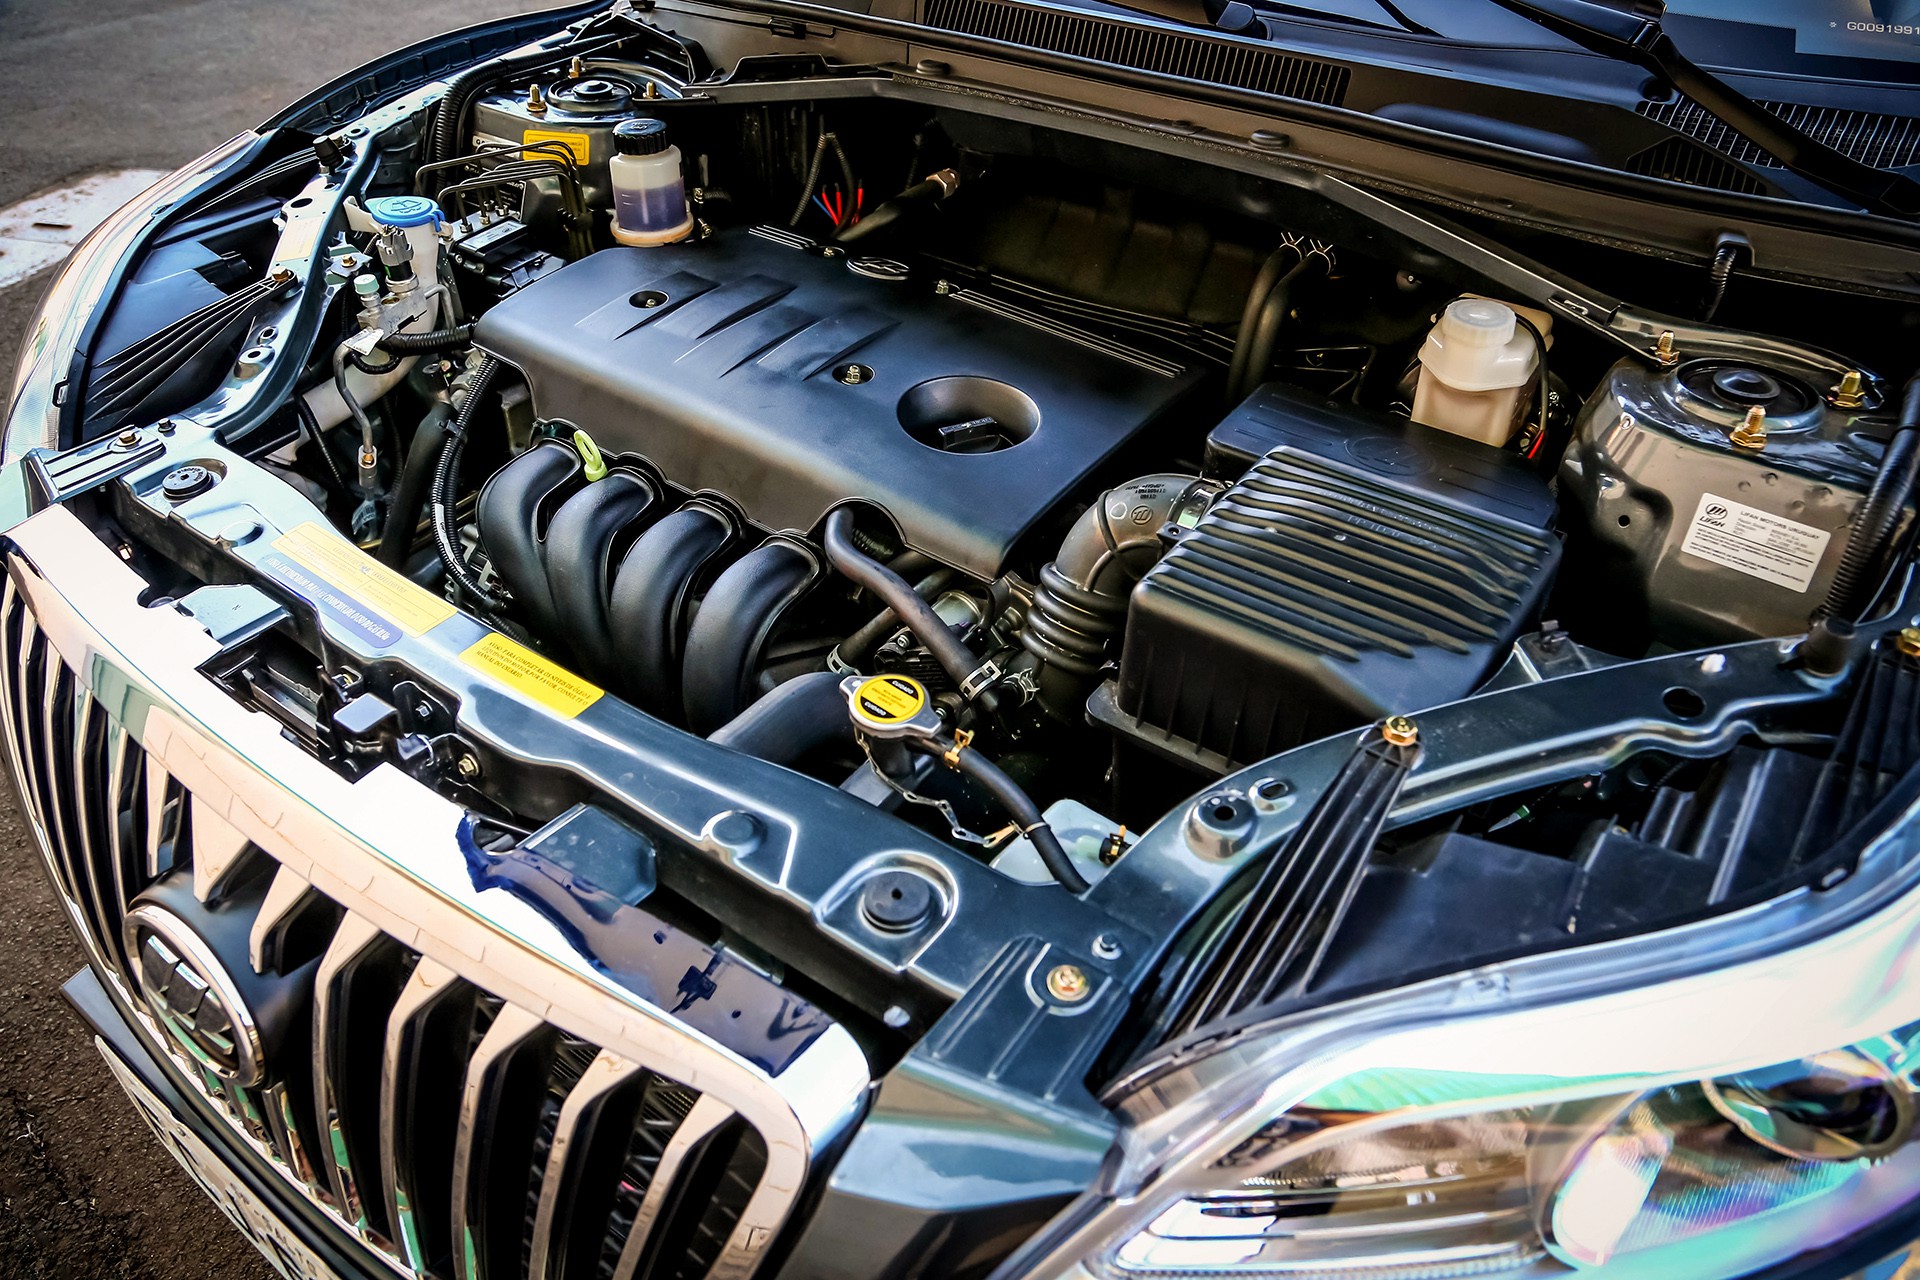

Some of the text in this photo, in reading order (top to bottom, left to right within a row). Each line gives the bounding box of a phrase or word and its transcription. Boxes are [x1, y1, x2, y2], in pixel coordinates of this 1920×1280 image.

[1699, 515, 1726, 528] LIFAN
[1740, 510, 1759, 520] LIFAN
[1759, 516, 1787, 529] MOTORS
[1788, 525, 1820, 540] URUGUAY
[515, 655, 544, 674] COMPLETAR
[892, 680, 914, 695] CUIDADO
[864, 701, 887, 716] CUIDADO
